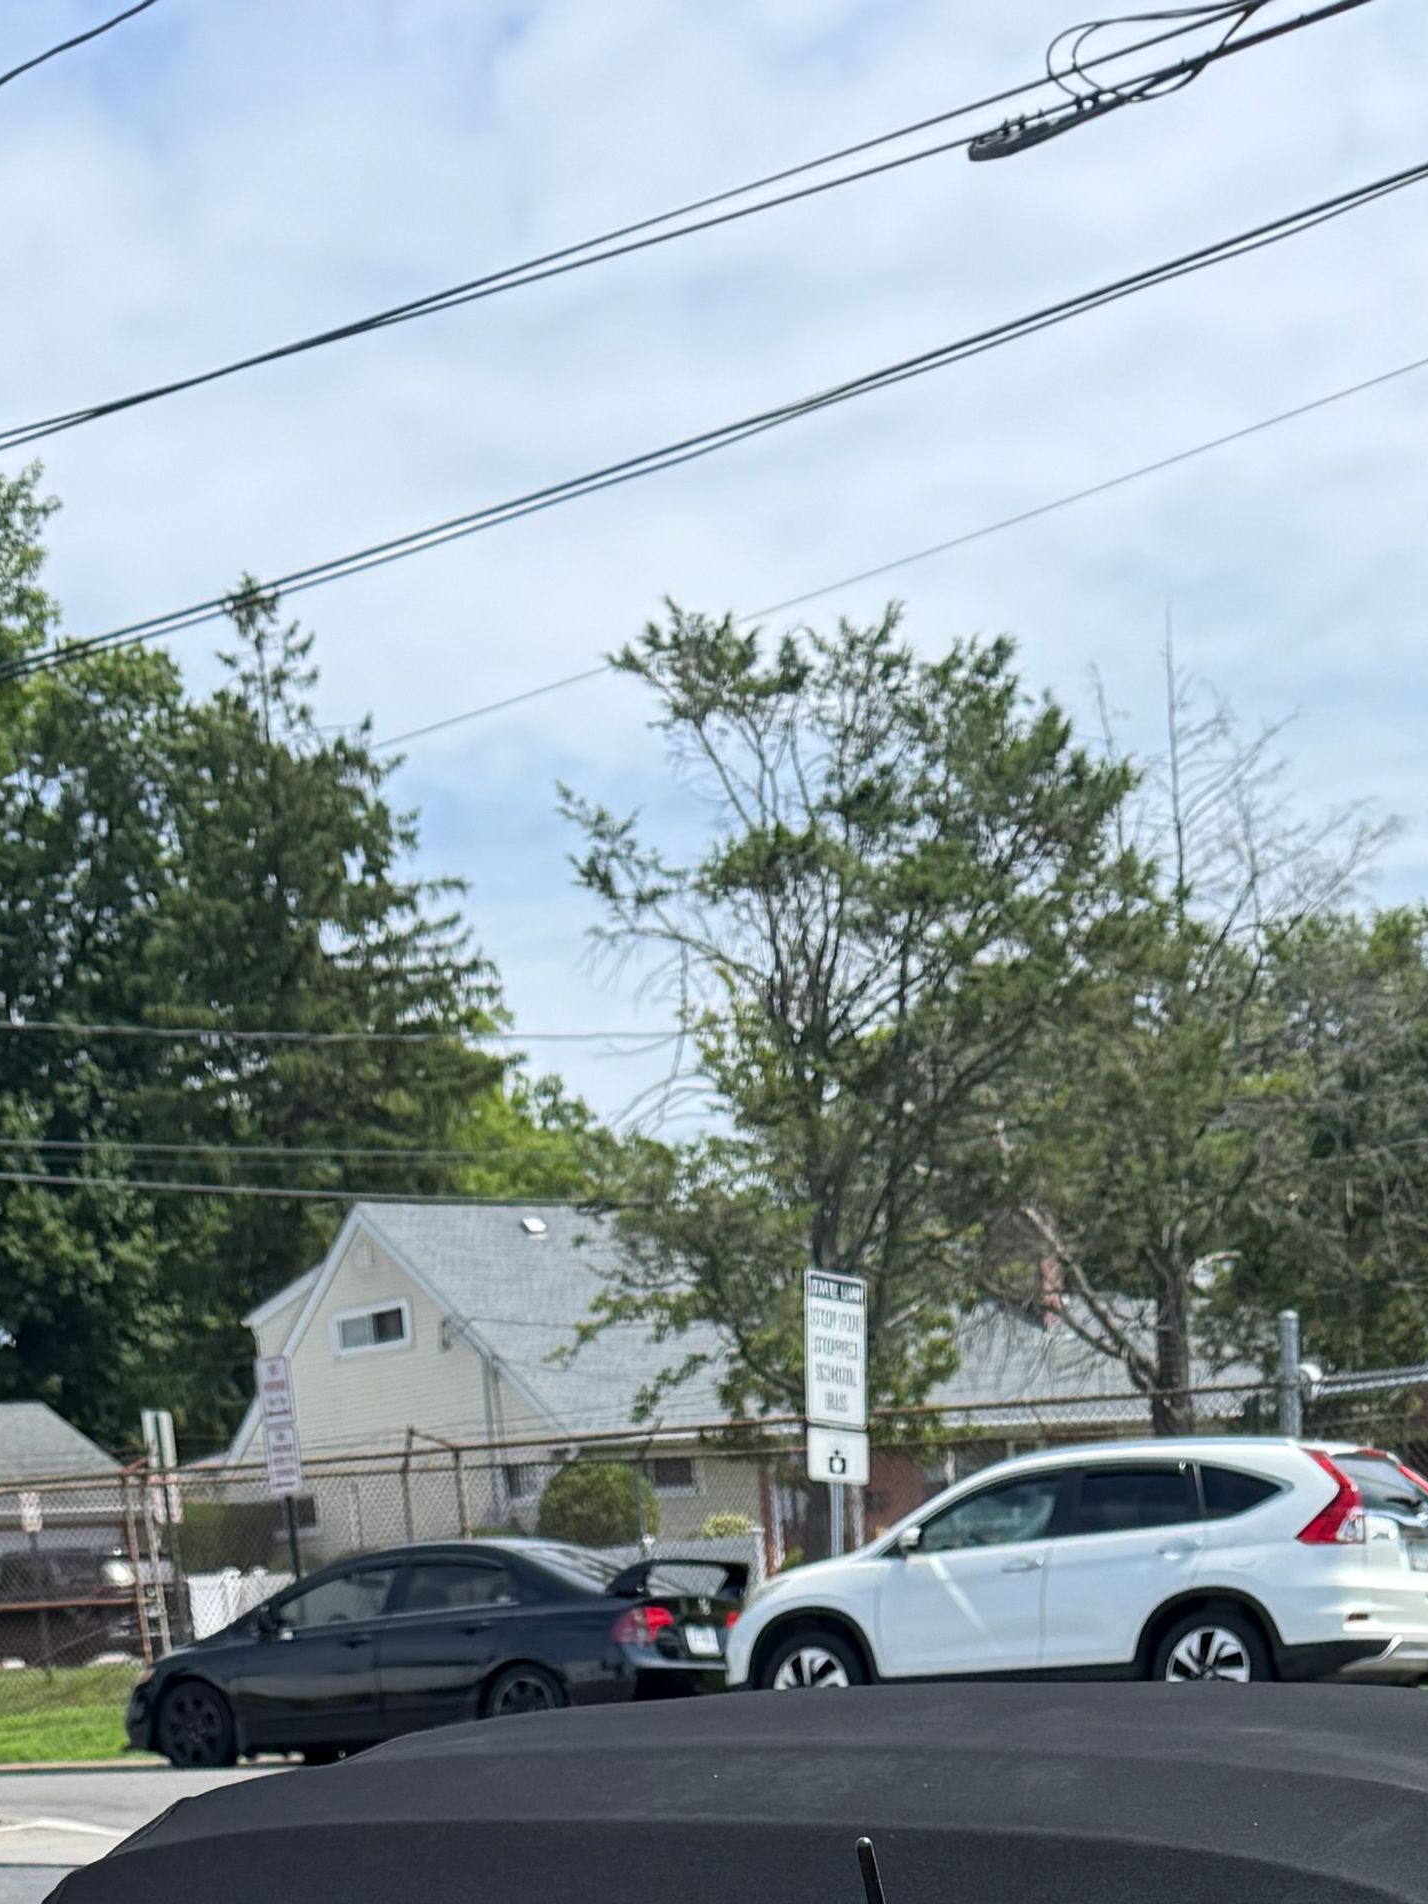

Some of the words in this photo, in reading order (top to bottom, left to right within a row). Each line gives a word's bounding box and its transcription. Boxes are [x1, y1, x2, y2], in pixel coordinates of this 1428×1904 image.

[810, 1307, 835, 1329] STOP
[815, 1363, 857, 1387] SCHOOL
[824, 1391, 849, 1412] BUS
